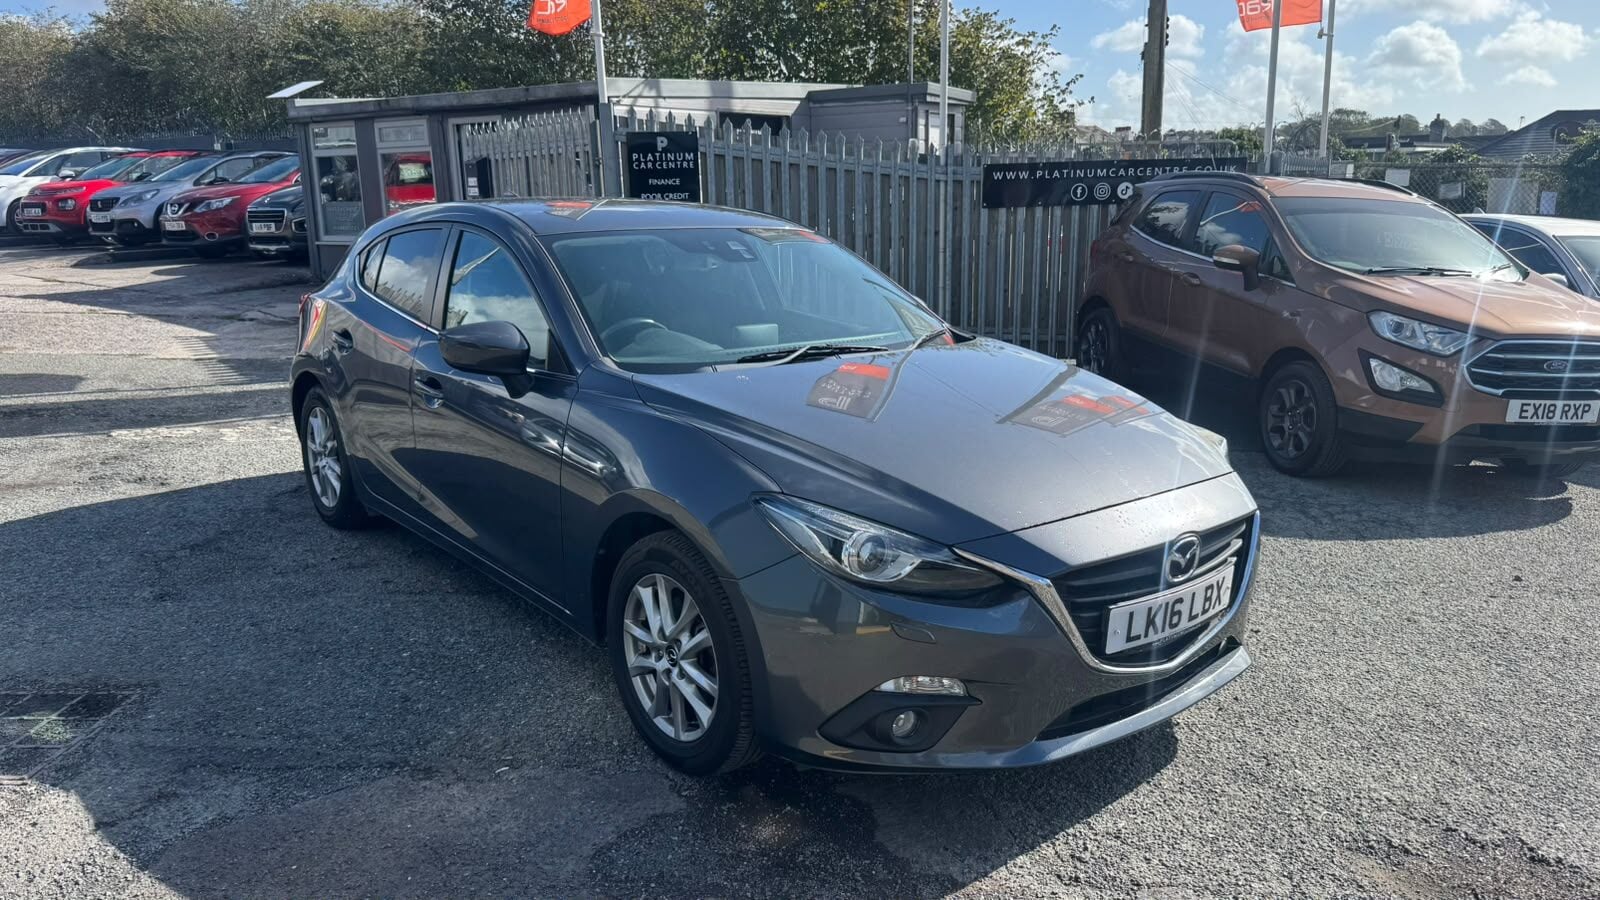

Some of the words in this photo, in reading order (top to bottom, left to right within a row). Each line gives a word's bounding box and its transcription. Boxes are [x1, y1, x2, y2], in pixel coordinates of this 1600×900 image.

[632, 152, 694, 161] PLATINUM
[633, 161, 653, 170] CAR
[656, 161, 695, 169] CENTRE
[993, 165, 1237, 180] WWW.PLATINUMCARCENTRECOUK
[664, 192, 689, 200] CREDIT
[1518, 403, 1557, 420] EX18
[1560, 403, 1592, 420] RXP
[1125, 597, 1184, 643] LK16
[1188, 576, 1225, 623] LBX
